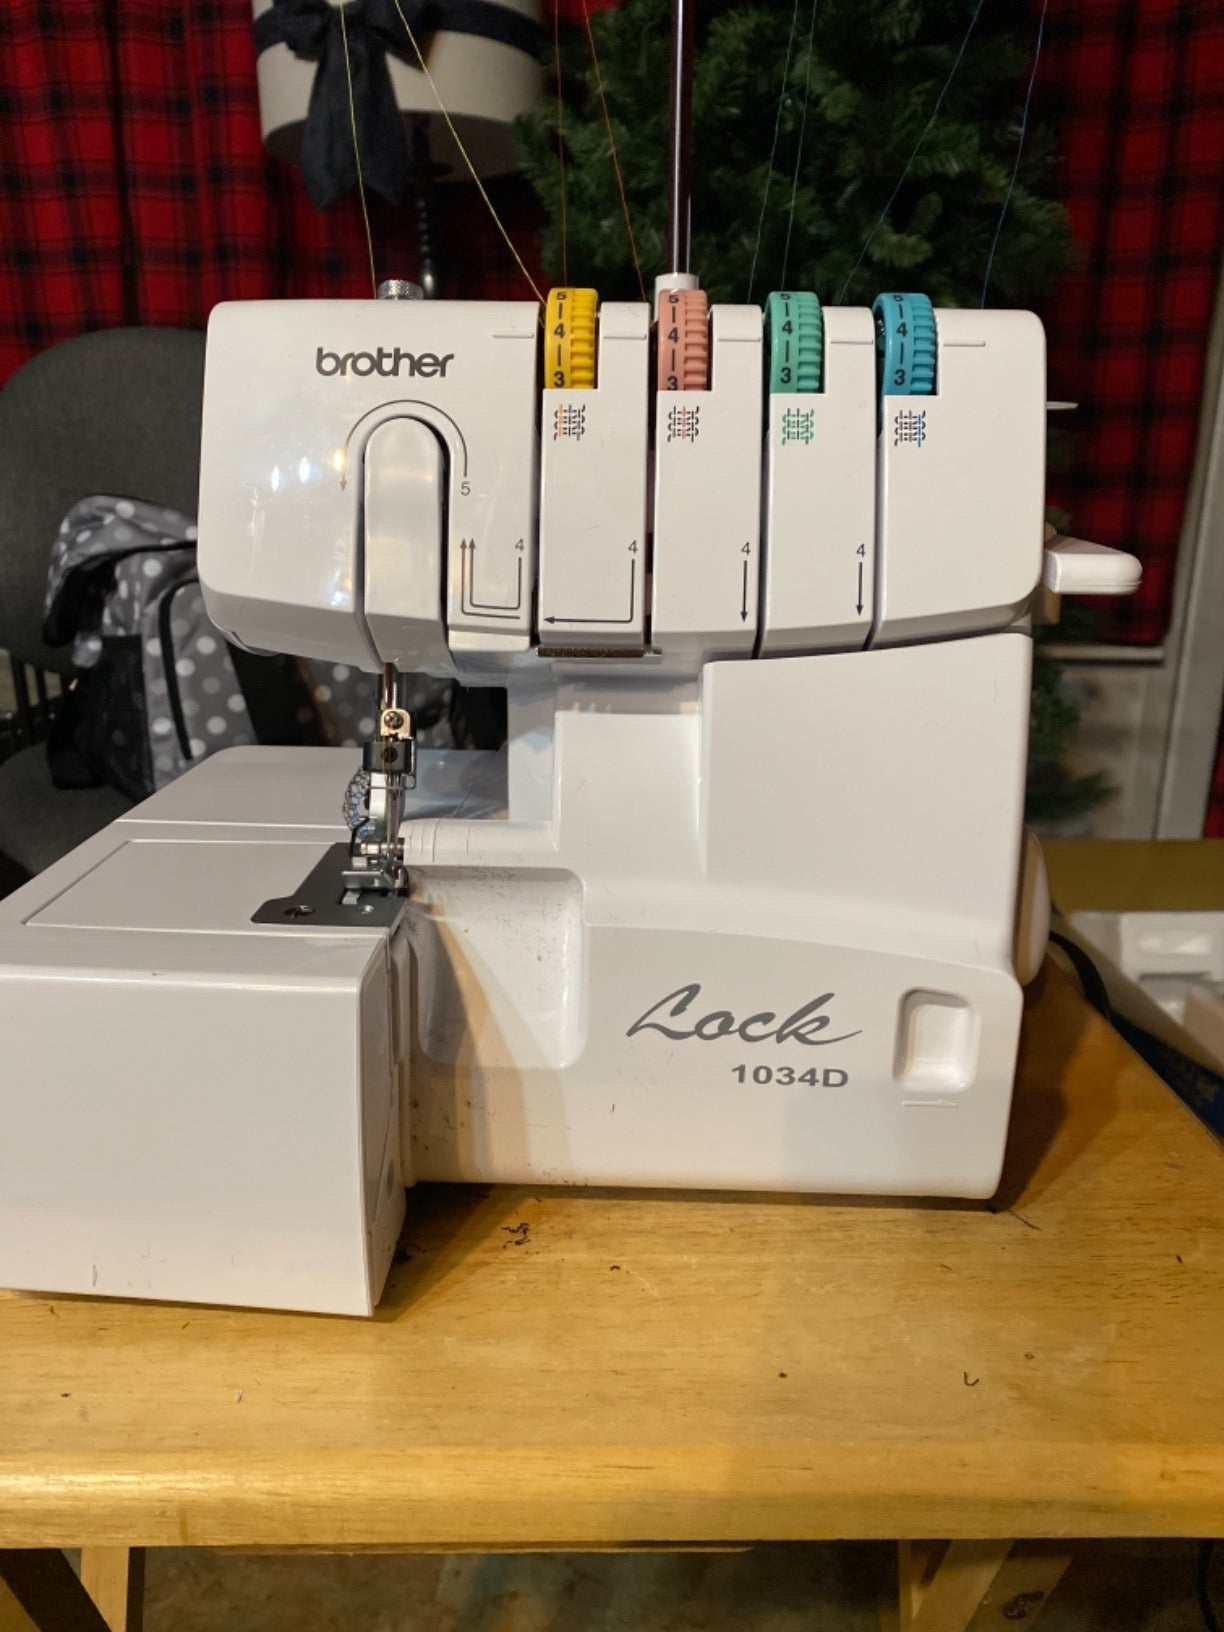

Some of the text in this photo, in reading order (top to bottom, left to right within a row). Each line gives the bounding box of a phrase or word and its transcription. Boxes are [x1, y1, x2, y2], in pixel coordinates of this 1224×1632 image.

[556, 291, 567, 300] 5
[668, 294, 679, 303] 5
[554, 323, 566, 339] 4
[782, 320, 793, 335] 4
[896, 322, 908, 337] 4
[668, 327, 679, 344] 4
[315, 346, 455, 378] brother
[553, 370, 565, 388] 3
[667, 375, 678, 390] 3
[780, 367, 792, 384] 3
[894, 368, 906, 386] 3
[460, 481, 471, 496] 5
[514, 538, 525, 551] 4
[628, 539, 638, 554] 4
[741, 541, 751, 556] 4
[856, 543, 866, 558] 4
[625, 982, 863, 1046] Lock
[731, 1064, 849, 1088] 1034D
